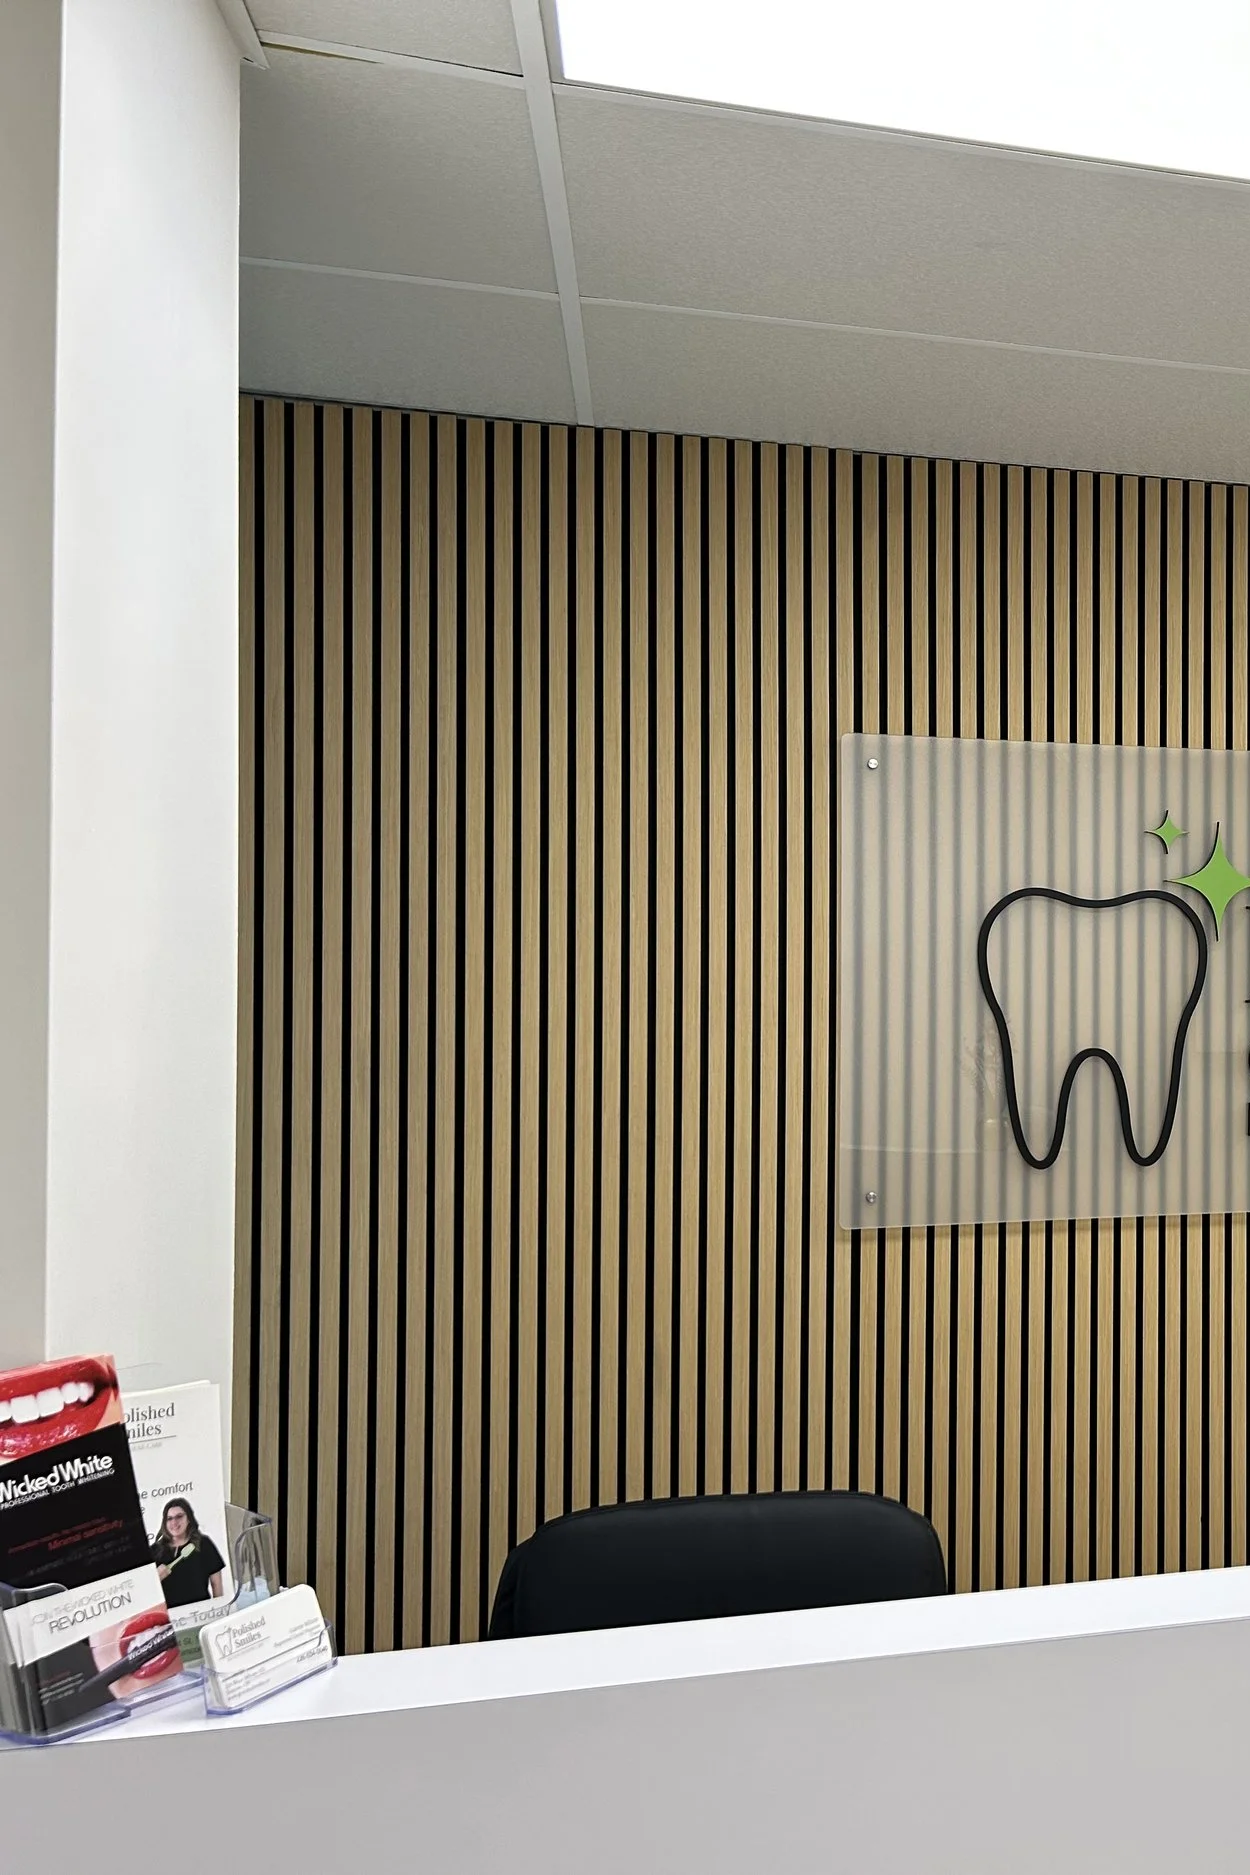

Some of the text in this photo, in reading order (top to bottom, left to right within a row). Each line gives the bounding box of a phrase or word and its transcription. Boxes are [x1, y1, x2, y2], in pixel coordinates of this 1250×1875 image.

[123, 1402, 175, 1424] olished
[127, 1423, 162, 1440] miles
[151, 1481, 193, 1498] comfort
[49, 1592, 132, 1634] REVOLUTION
[189, 1604, 231, 1622] Today
[232, 1616, 266, 1638] Polished
[234, 1630, 262, 1648] Smiles
